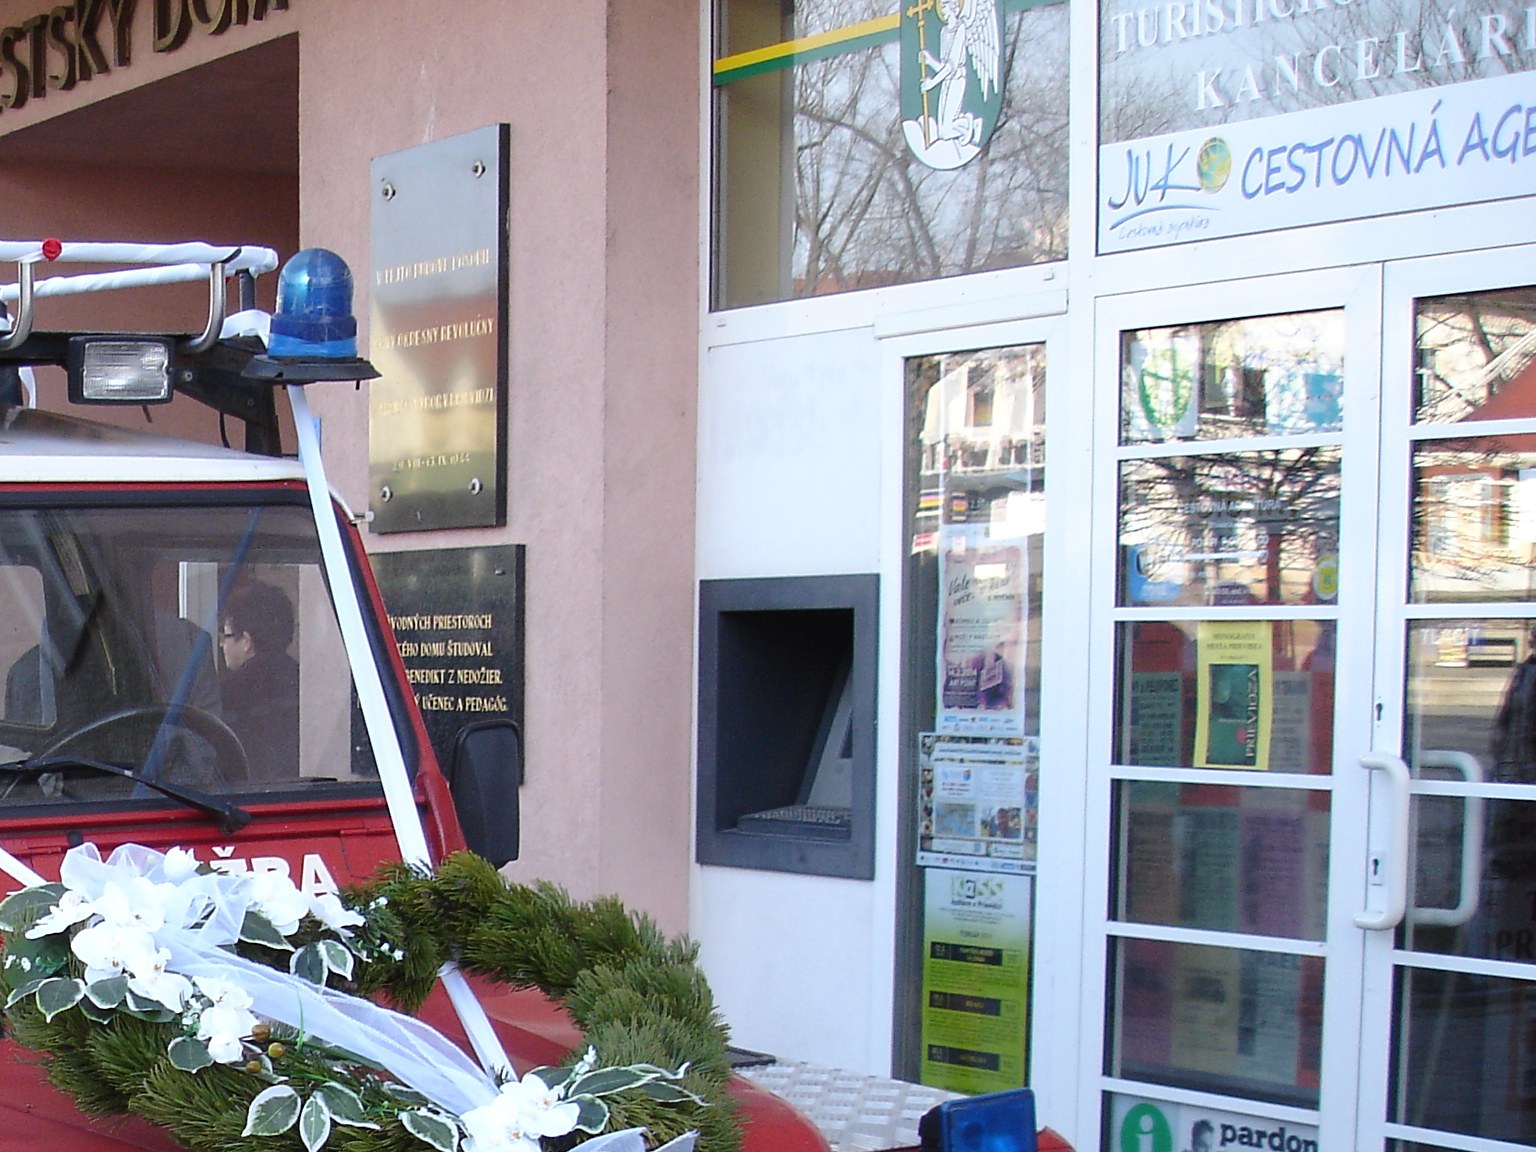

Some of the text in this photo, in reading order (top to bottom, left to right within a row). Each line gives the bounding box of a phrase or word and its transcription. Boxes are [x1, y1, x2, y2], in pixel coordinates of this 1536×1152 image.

[1241, 99, 1446, 200] CESTOVNÁ
[389, 613, 492, 630] VODNÝCH PRIESTOROCH
[420, 642, 445, 657] DOMU
[447, 640, 493, 657] ŠTUDOVAL
[423, 694, 455, 711] UČENEC
[456, 697, 463, 711] A
